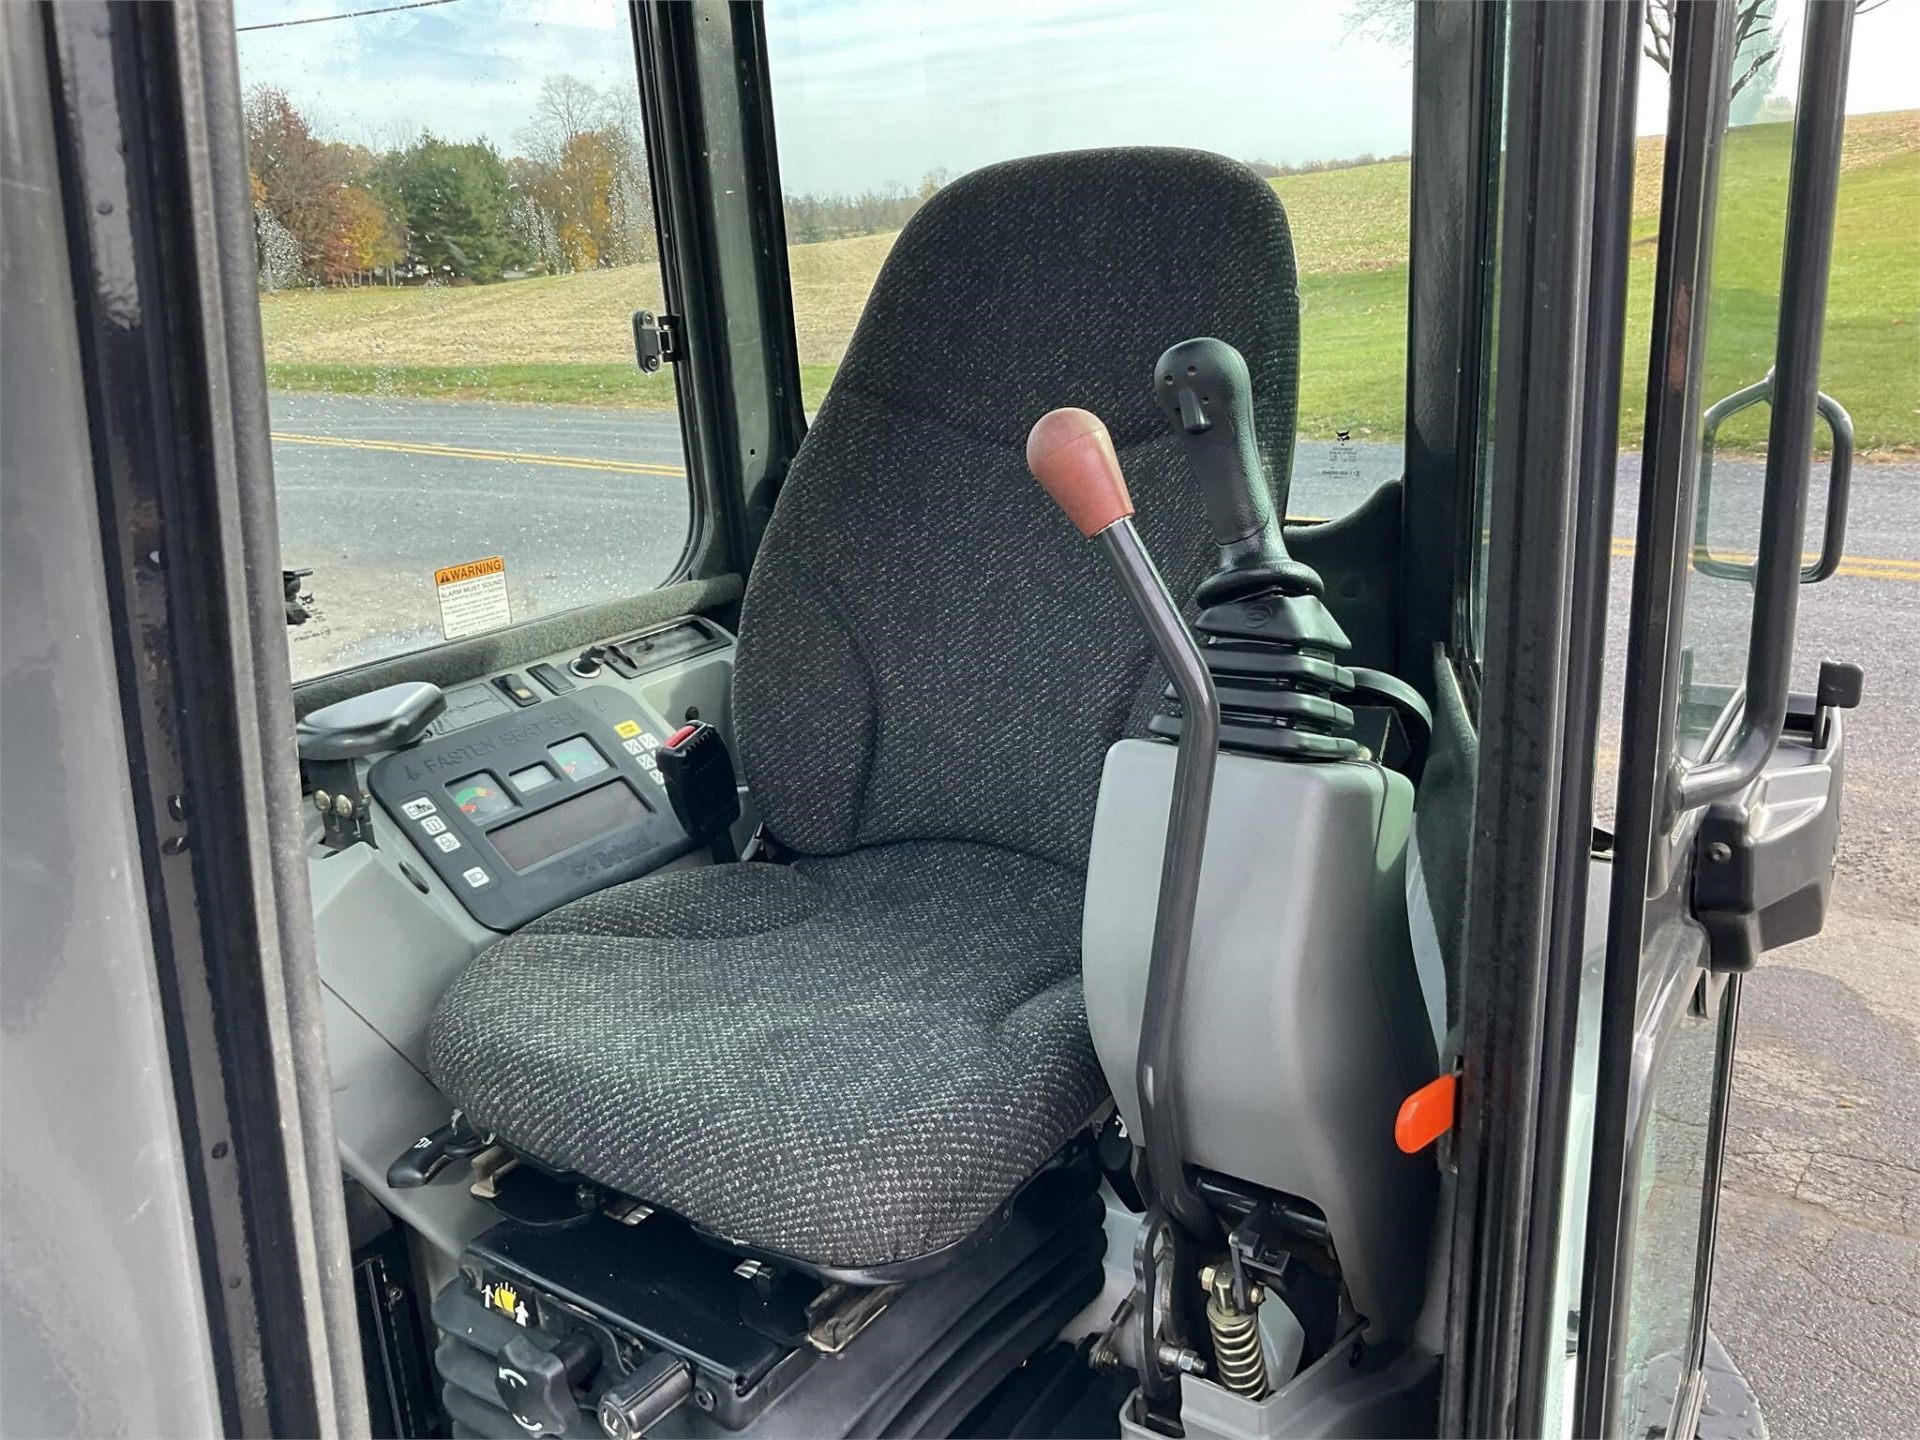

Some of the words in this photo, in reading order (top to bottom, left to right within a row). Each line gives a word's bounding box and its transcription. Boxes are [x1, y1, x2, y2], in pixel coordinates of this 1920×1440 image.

[450, 559, 502, 580] WARNING
[441, 589, 463, 599] ALARM
[463, 584, 480, 593] MUST
[482, 579, 503, 589] SOUND
[424, 736, 500, 773] FASTEN
[498, 720, 545, 746] SEAT
